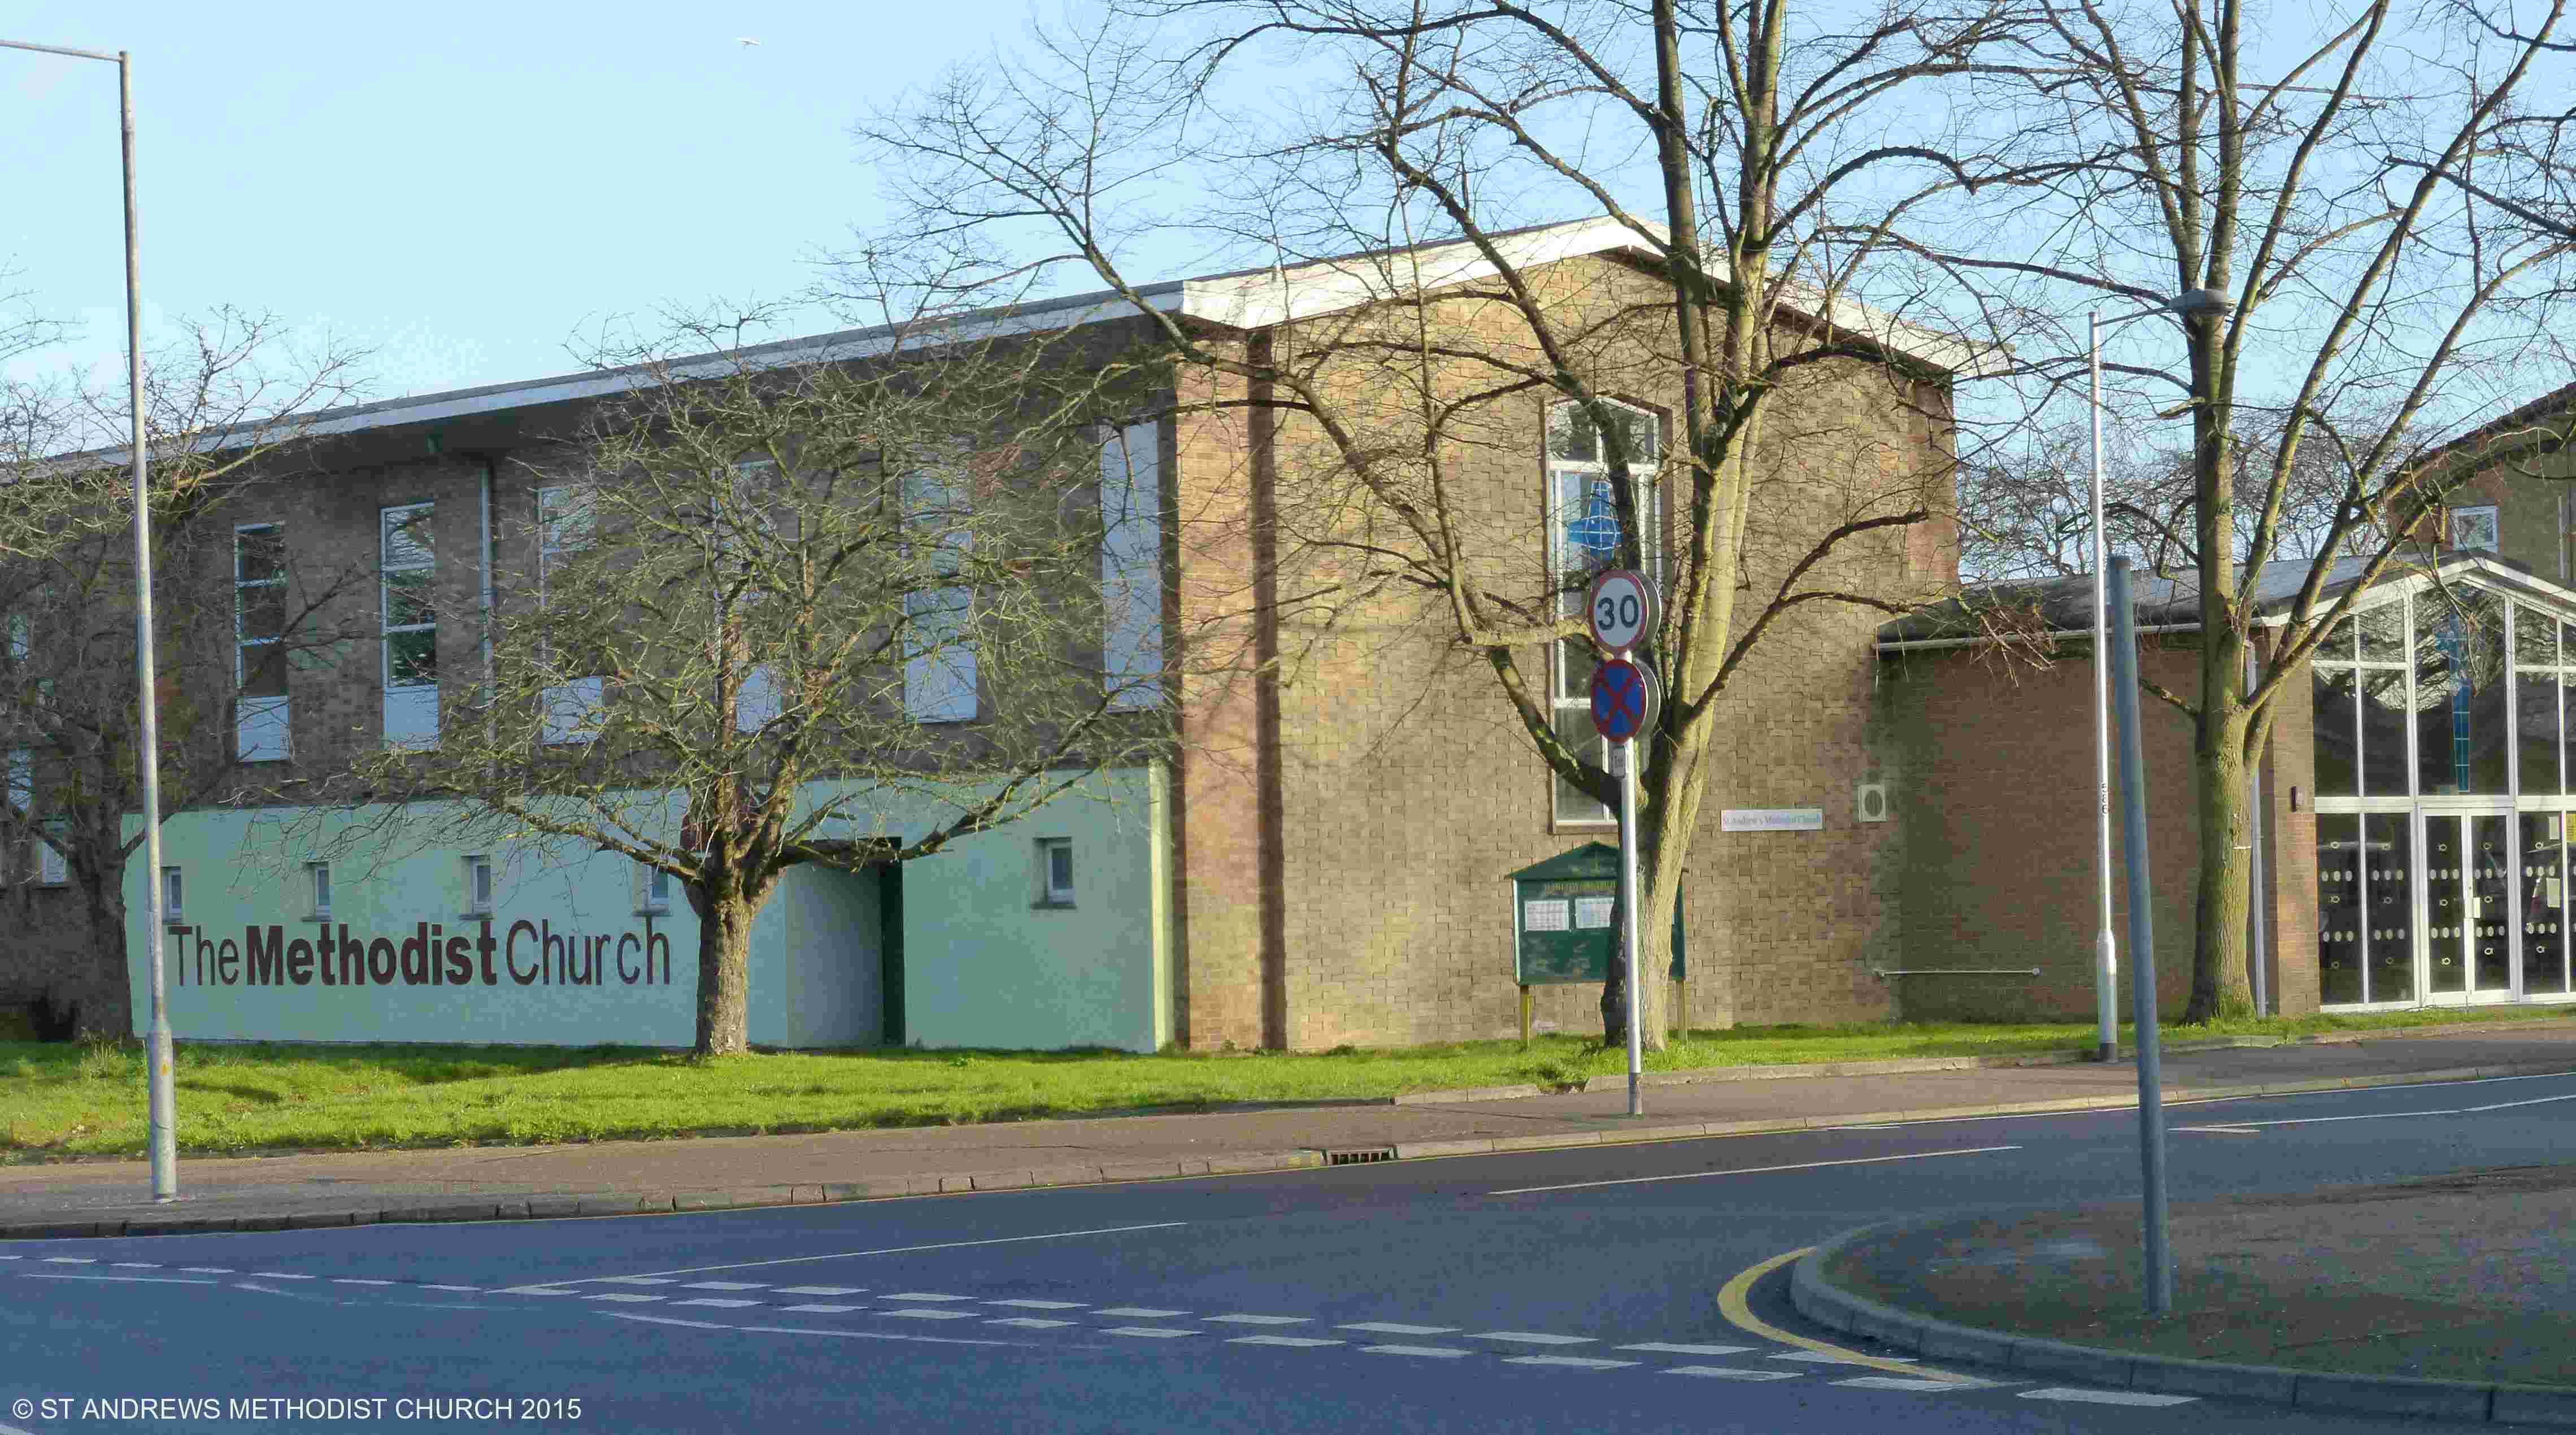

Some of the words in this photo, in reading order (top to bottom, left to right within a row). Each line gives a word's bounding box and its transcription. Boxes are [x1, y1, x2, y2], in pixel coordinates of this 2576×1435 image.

[1598, 595, 1639, 631] 30
[167, 925, 240, 986] The
[246, 920, 498, 986] Methodist
[506, 918, 671, 986] Church
